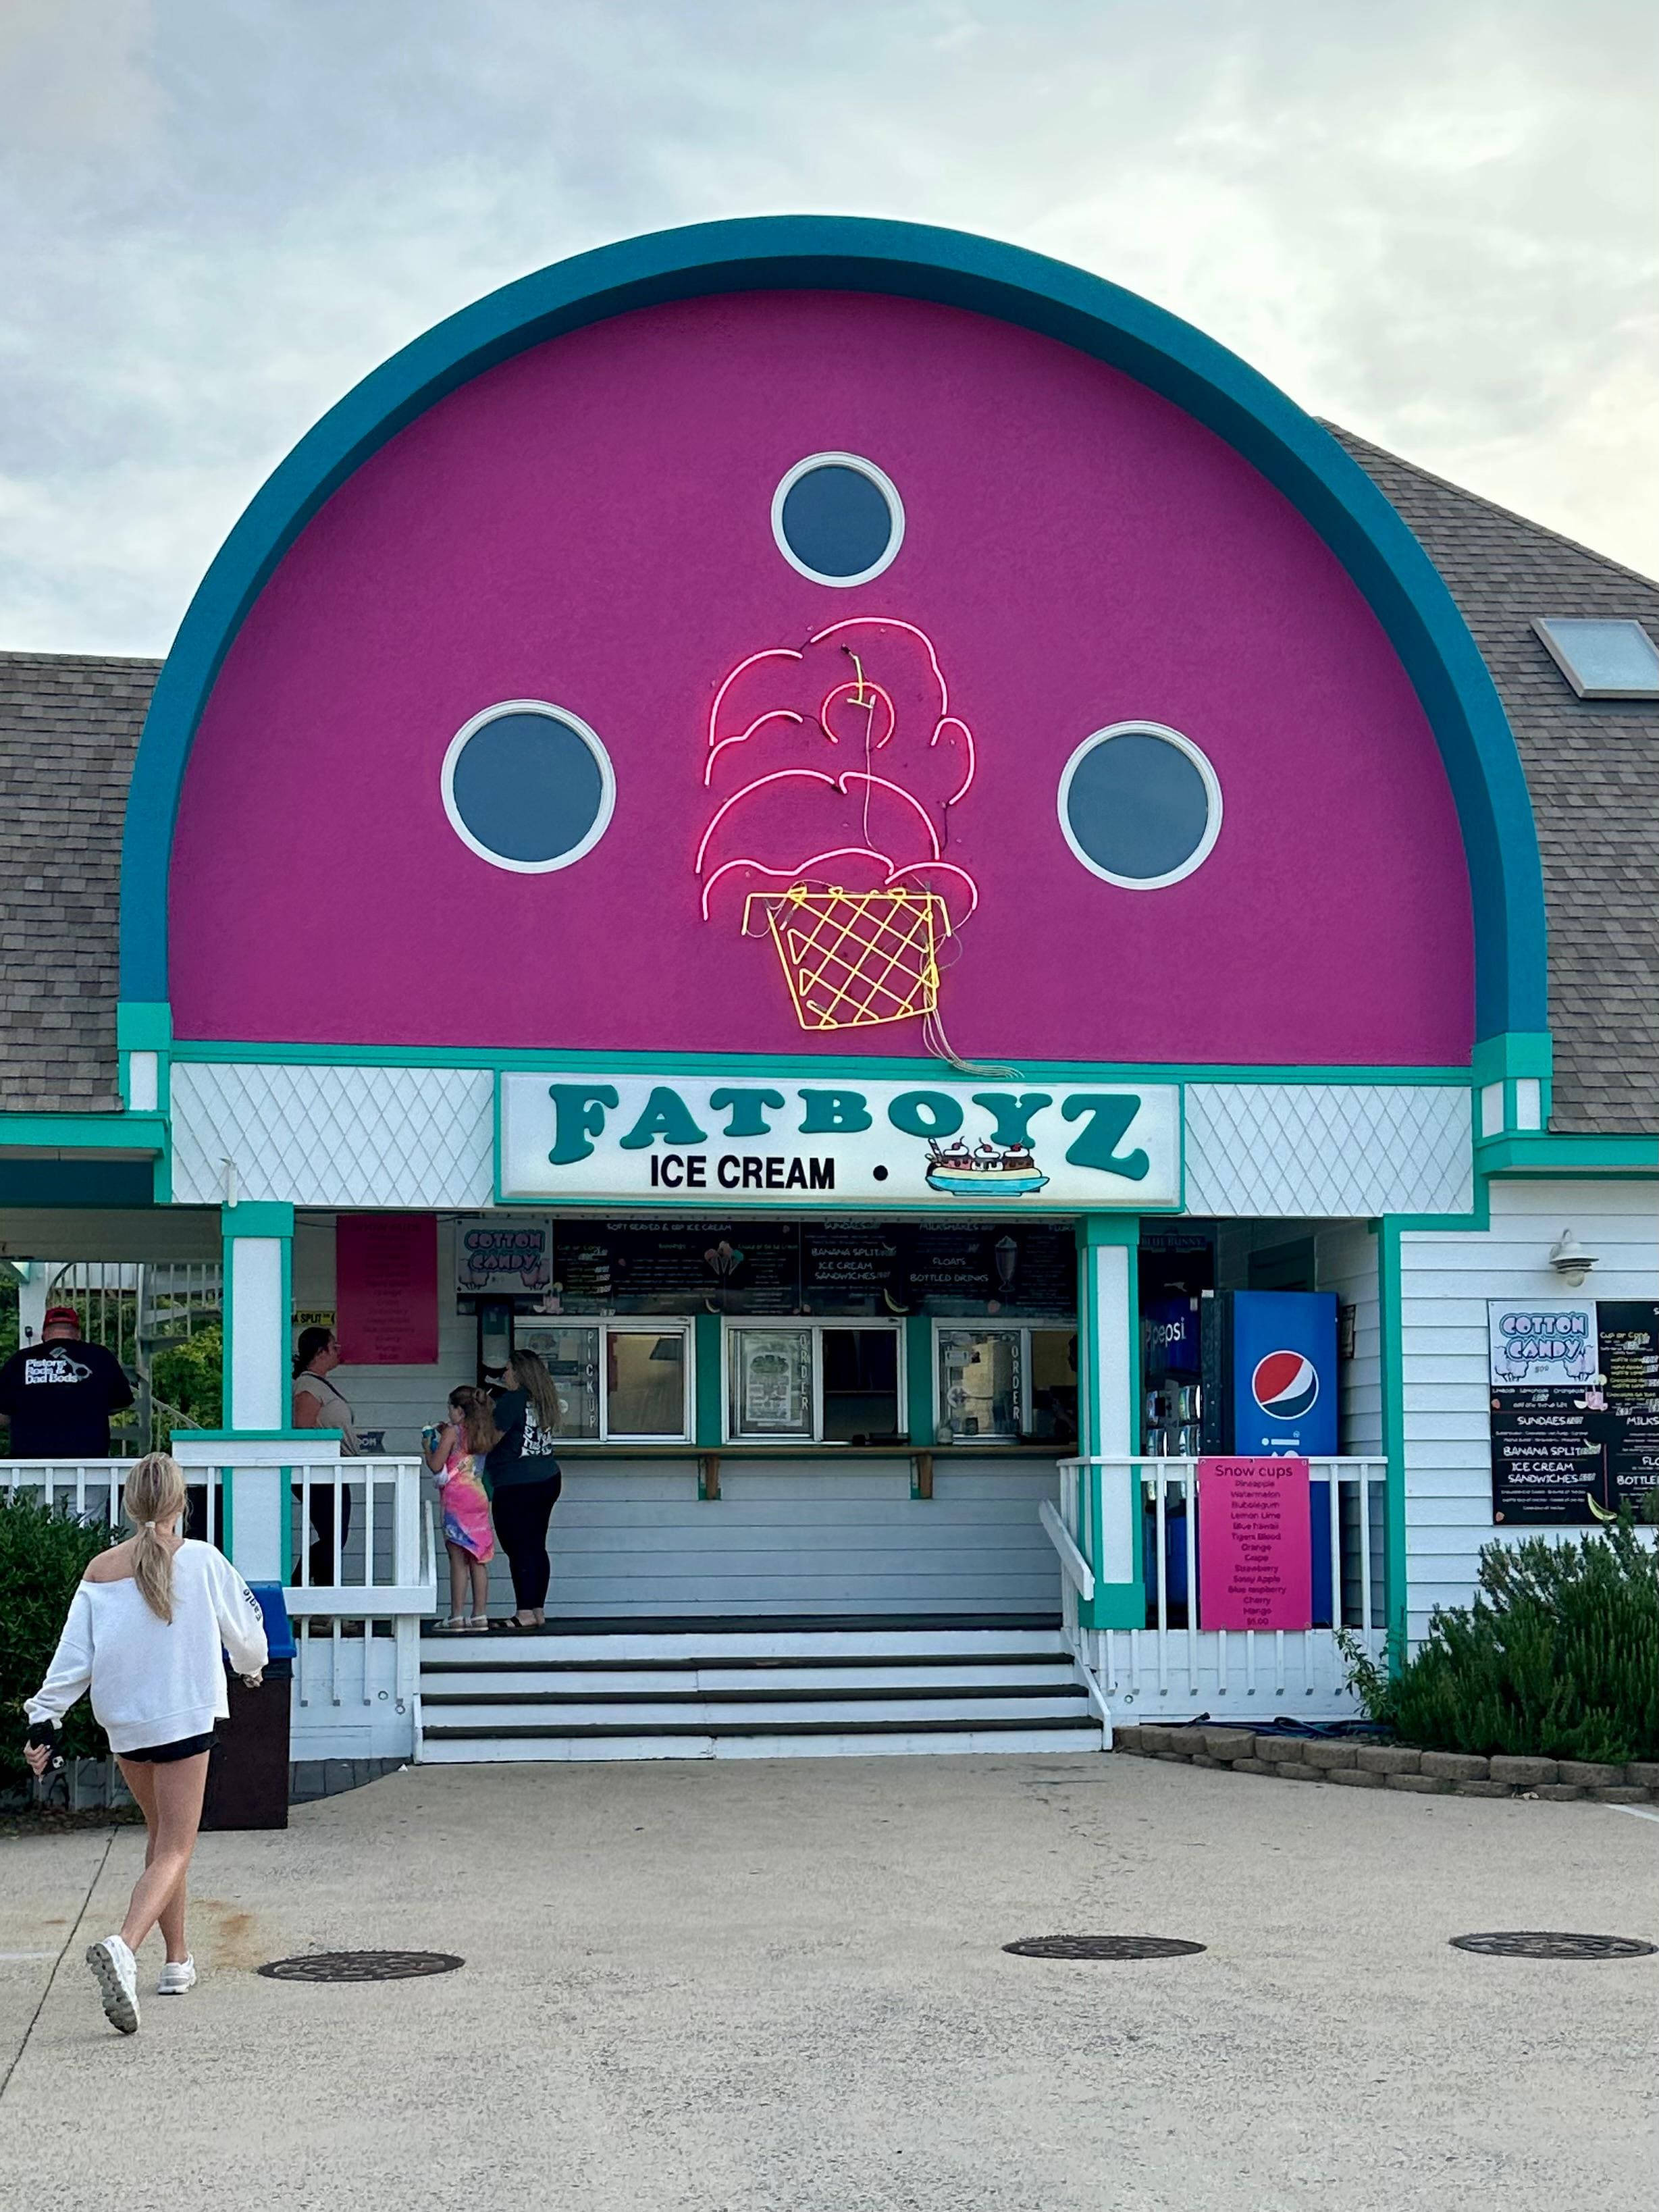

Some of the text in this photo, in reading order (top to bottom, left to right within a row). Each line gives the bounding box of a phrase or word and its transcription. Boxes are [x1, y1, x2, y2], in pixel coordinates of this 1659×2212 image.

[548, 1083, 1151, 1182] FATBOYZ
[650, 1155, 835, 1190] ICE CREAM
[466, 1231, 544, 1250] COTTON
[812, 1248, 879, 1257] BANANA SPLIT
[471, 1252, 538, 1271] CANDY
[818, 1261, 873, 1270] ICE CREAM
[932, 1257, 967, 1266] FLOATS
[814, 1271, 876, 1280] SANDWICHES
[910, 1274, 989, 1283] BOTTLED DRINKS
[1501, 1314, 1587, 1336] COTTON
[1152, 1317, 1187, 1349] pepsi
[1507, 1338, 1583, 1361] CANDY
[26, 1359, 66, 1367] Pistons
[26, 1365, 66, 1375] Rods &
[799, 1334, 809, 1411] ORDER
[26, 1373, 78, 1384] Dad Bods
[1012, 1346, 1020, 1420] ORDER
[1517, 1416, 1566, 1425] SUNDAES
[1503, 1446, 1548, 1456] BANANA
[1550, 1446, 1580, 1456] SPLIT
[1511, 1462, 1574, 1471] ICE CREAM
[1215, 1465, 1293, 1479] Snow cups
[1508, 1473, 1579, 1483] SANDWICHES
[1231, 1533, 1256, 1542] Tigers
[1241, 1544, 1272, 1552] Orange
[1234, 1564, 1279, 1574] Strawberry
[1257, 1575, 1281, 1584] Apple
[1228, 1585, 1246, 1594] Blue
[1243, 1596, 1271, 1606] Cherry
[1242, 1607, 1272, 1616] Mango
